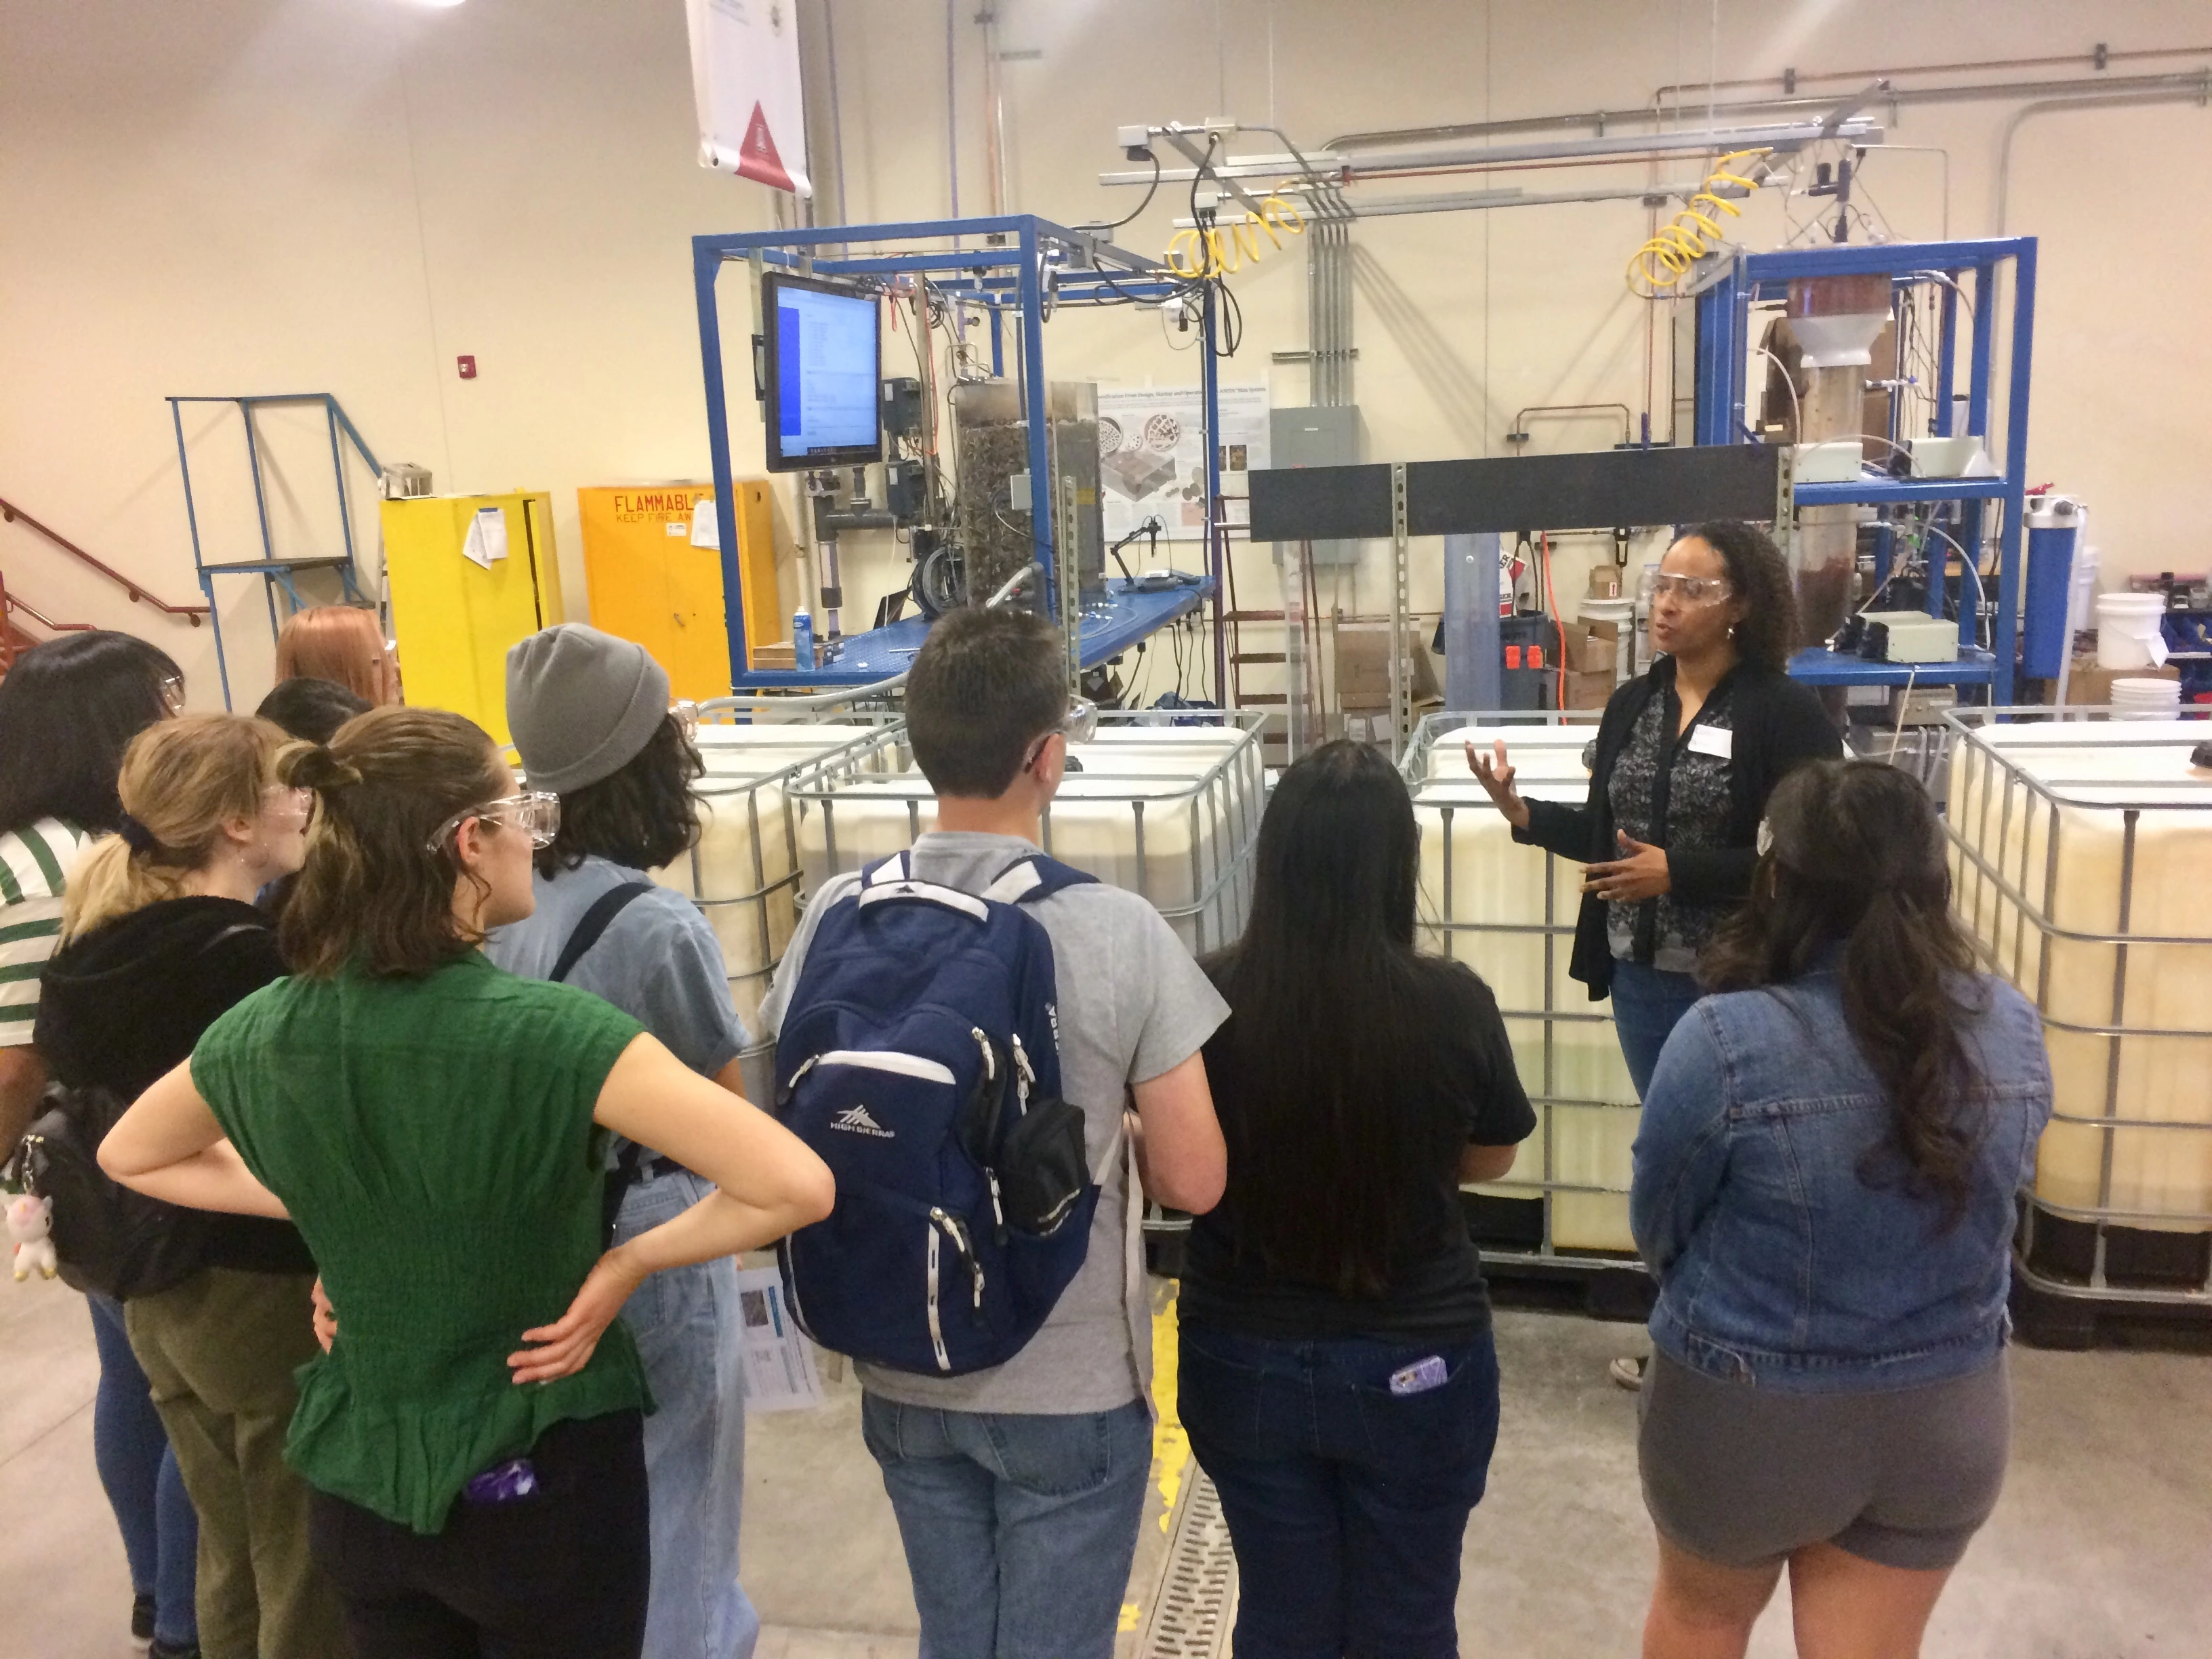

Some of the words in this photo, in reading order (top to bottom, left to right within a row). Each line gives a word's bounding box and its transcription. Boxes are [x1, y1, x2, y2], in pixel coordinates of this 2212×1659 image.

[614, 493, 704, 512] FLAMMABL
[616, 513, 644, 523] KEEP
[648, 512, 672, 523] FIRE
[678, 512, 691, 521] AW
[830, 1122, 855, 1132] HIGH
